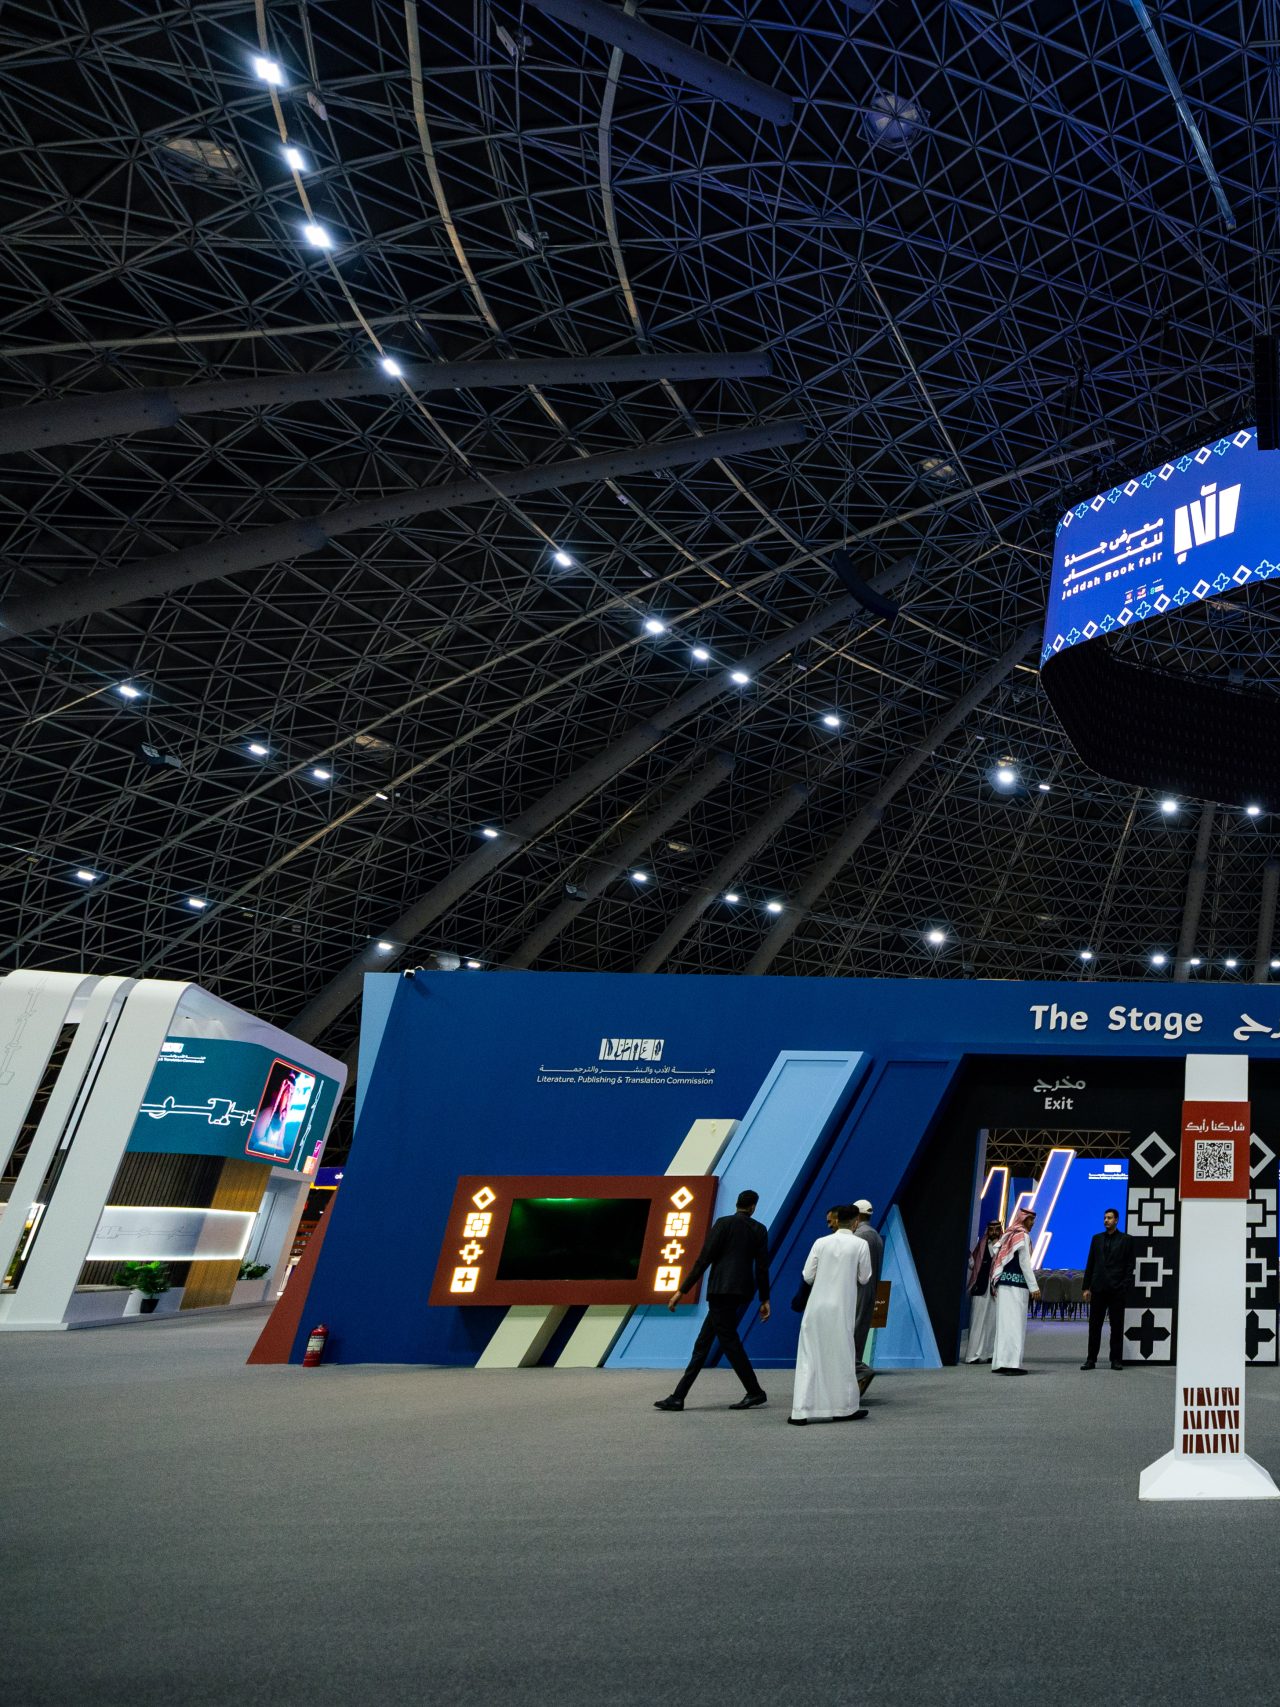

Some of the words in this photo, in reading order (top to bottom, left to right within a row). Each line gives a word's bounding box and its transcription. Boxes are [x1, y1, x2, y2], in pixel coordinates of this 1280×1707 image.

[1108, 517, 1164, 551] معرض
[1063, 531, 1164, 587] للكتاب
[1064, 541, 1108, 567] جدة
[1061, 576, 1101, 601] Jeddah
[1104, 562, 1135, 582] Book
[1138, 551, 1163, 569] fair
[1029, 1002, 1089, 1032] The
[1107, 1005, 1204, 1040] Stage
[536, 1075, 577, 1084] Literature,
[577, 1076, 616, 1086] Publishing
[616, 1076, 623, 1084] &
[624, 1076, 666, 1085] Translation
[666, 1077, 714, 1085] Commission
[1032, 1074, 1087, 1094] مخرج
[1044, 1096, 1074, 1111] Exit
[1184, 1118, 1210, 1133] رأيك
[1210, 1119, 1245, 1133] شاركنا
